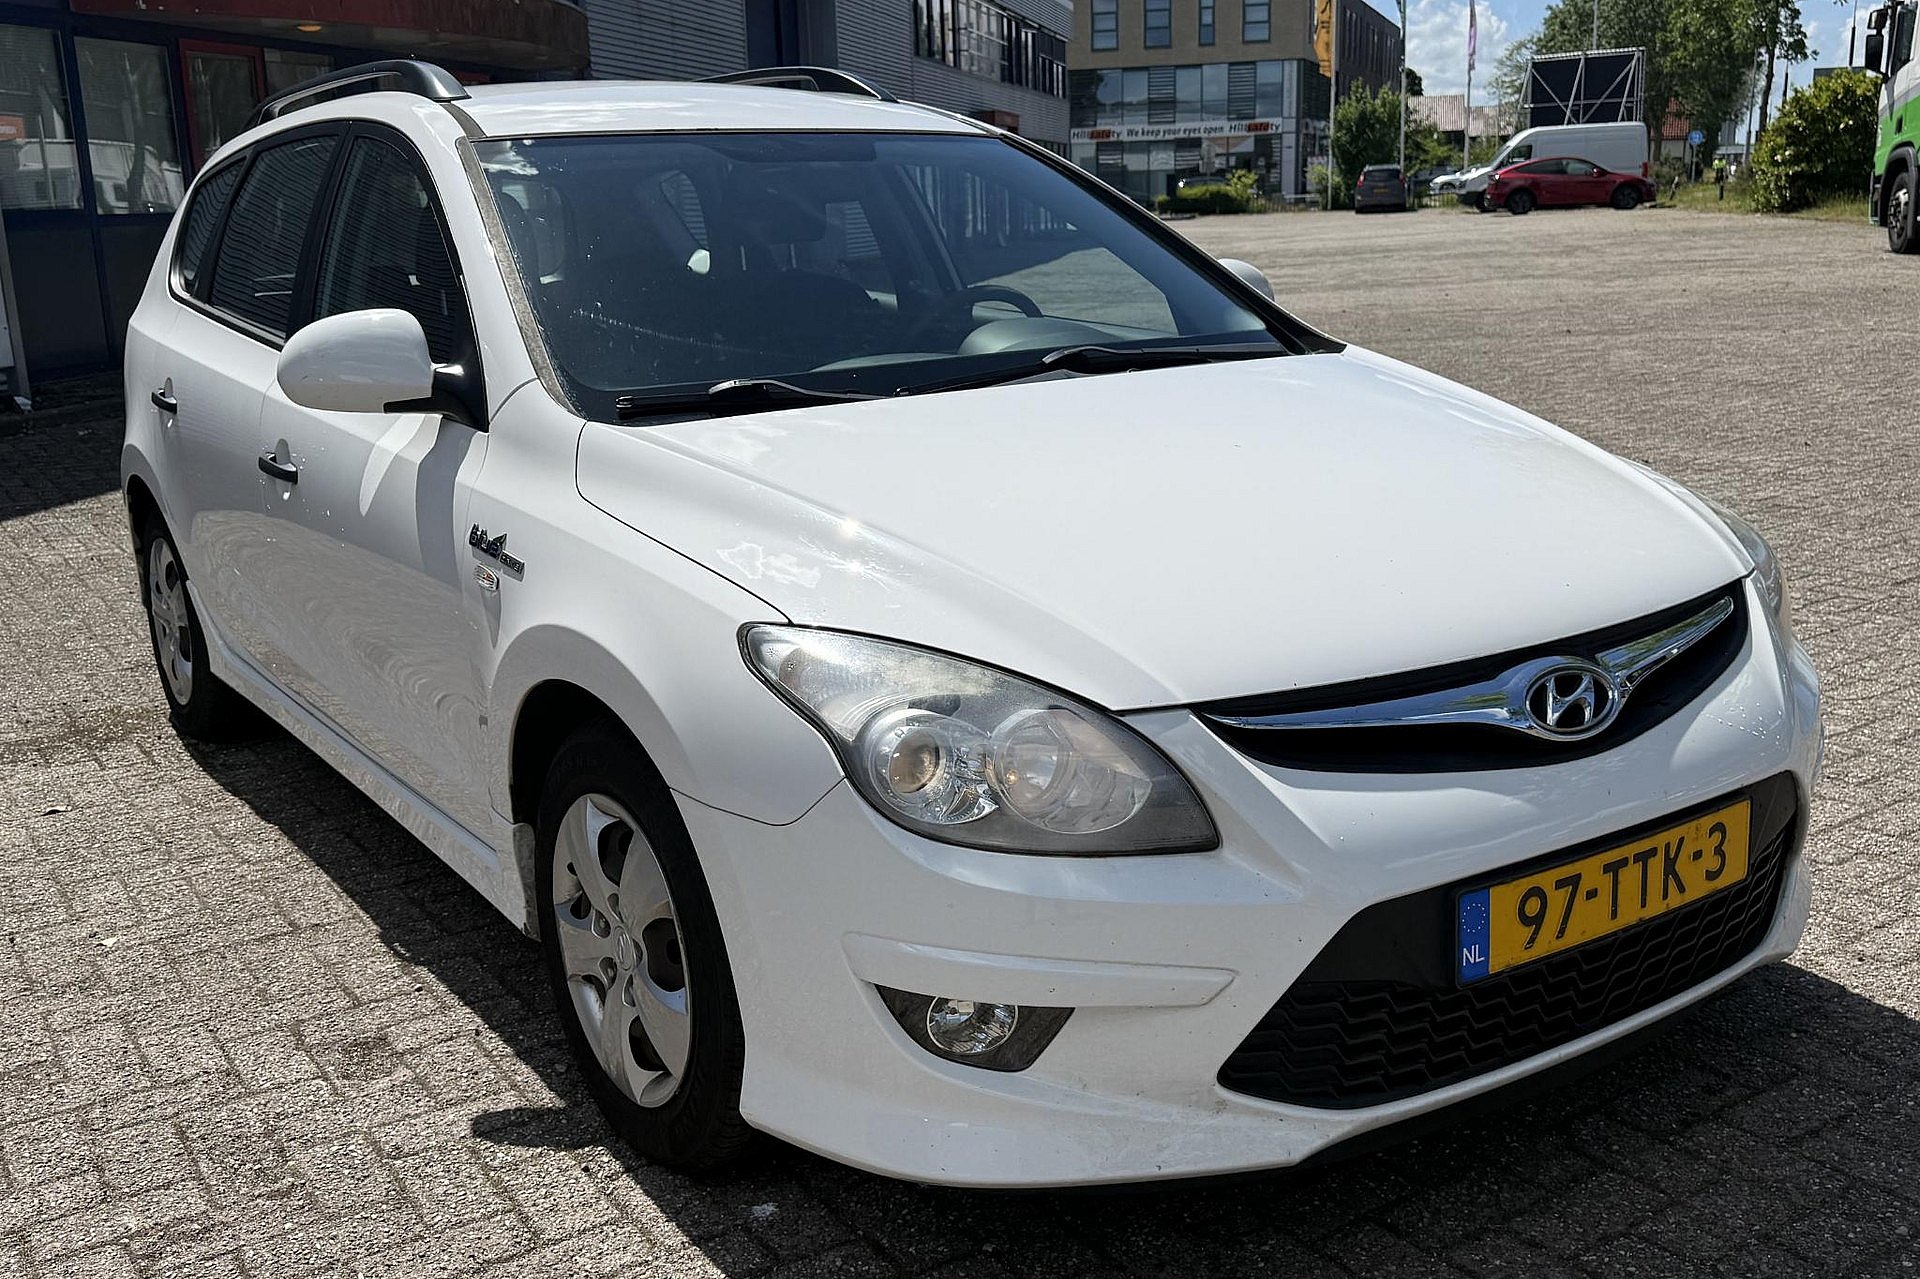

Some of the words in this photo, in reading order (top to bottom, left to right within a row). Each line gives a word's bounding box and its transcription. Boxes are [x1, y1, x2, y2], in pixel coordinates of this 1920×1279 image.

[1126, 127, 1139, 137] We
[1141, 127, 1160, 138] keep
[1162, 126, 1181, 138] your
[1183, 126, 1201, 138] eyes
[1203, 124, 1224, 136] open
[1517, 822, 1727, 949] 97-TTK-3
[1463, 944, 1485, 966] NL
